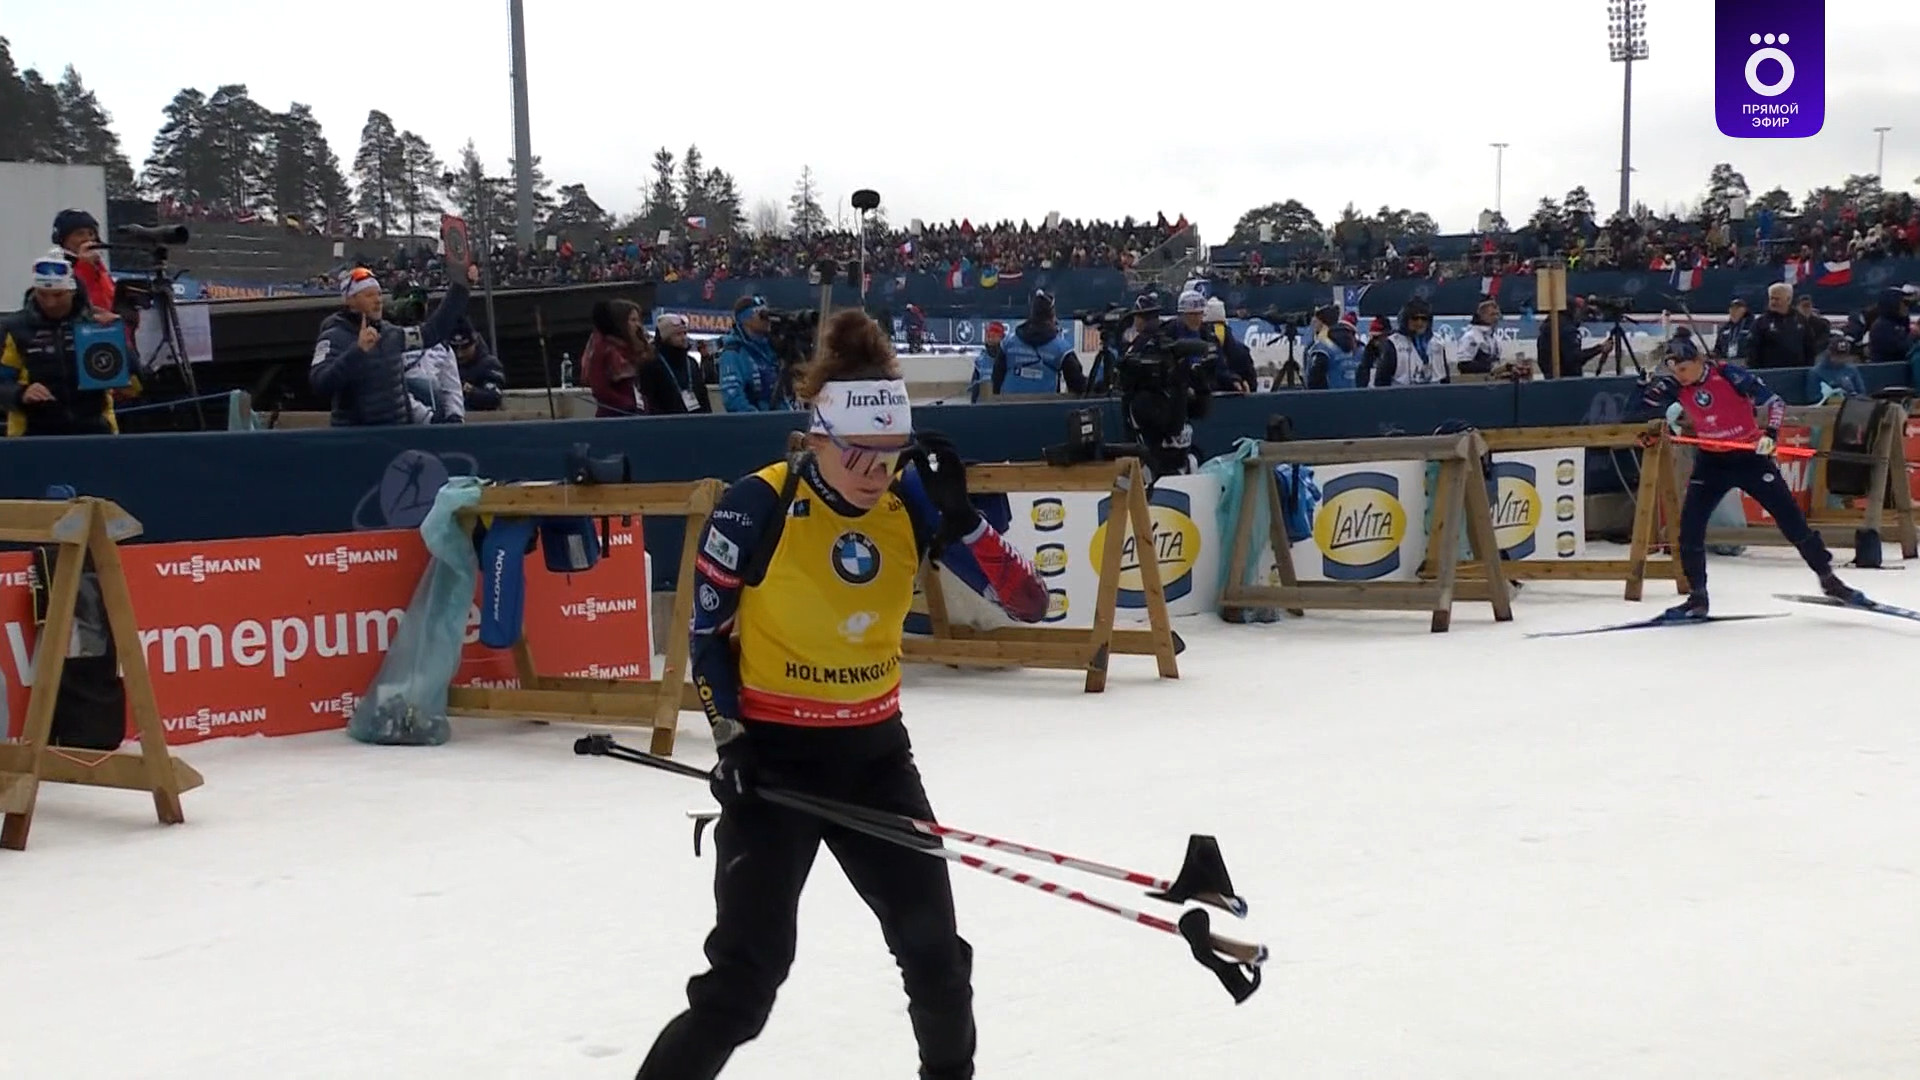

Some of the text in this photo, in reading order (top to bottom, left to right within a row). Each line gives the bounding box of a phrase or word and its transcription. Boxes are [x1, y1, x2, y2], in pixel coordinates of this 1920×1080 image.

[155, 554, 261, 583] VIESSMANN
[305, 546, 398, 573] VIESSMANN
[561, 597, 637, 621] VIESSMANN
[162, 708, 267, 736] VIESSMANN
